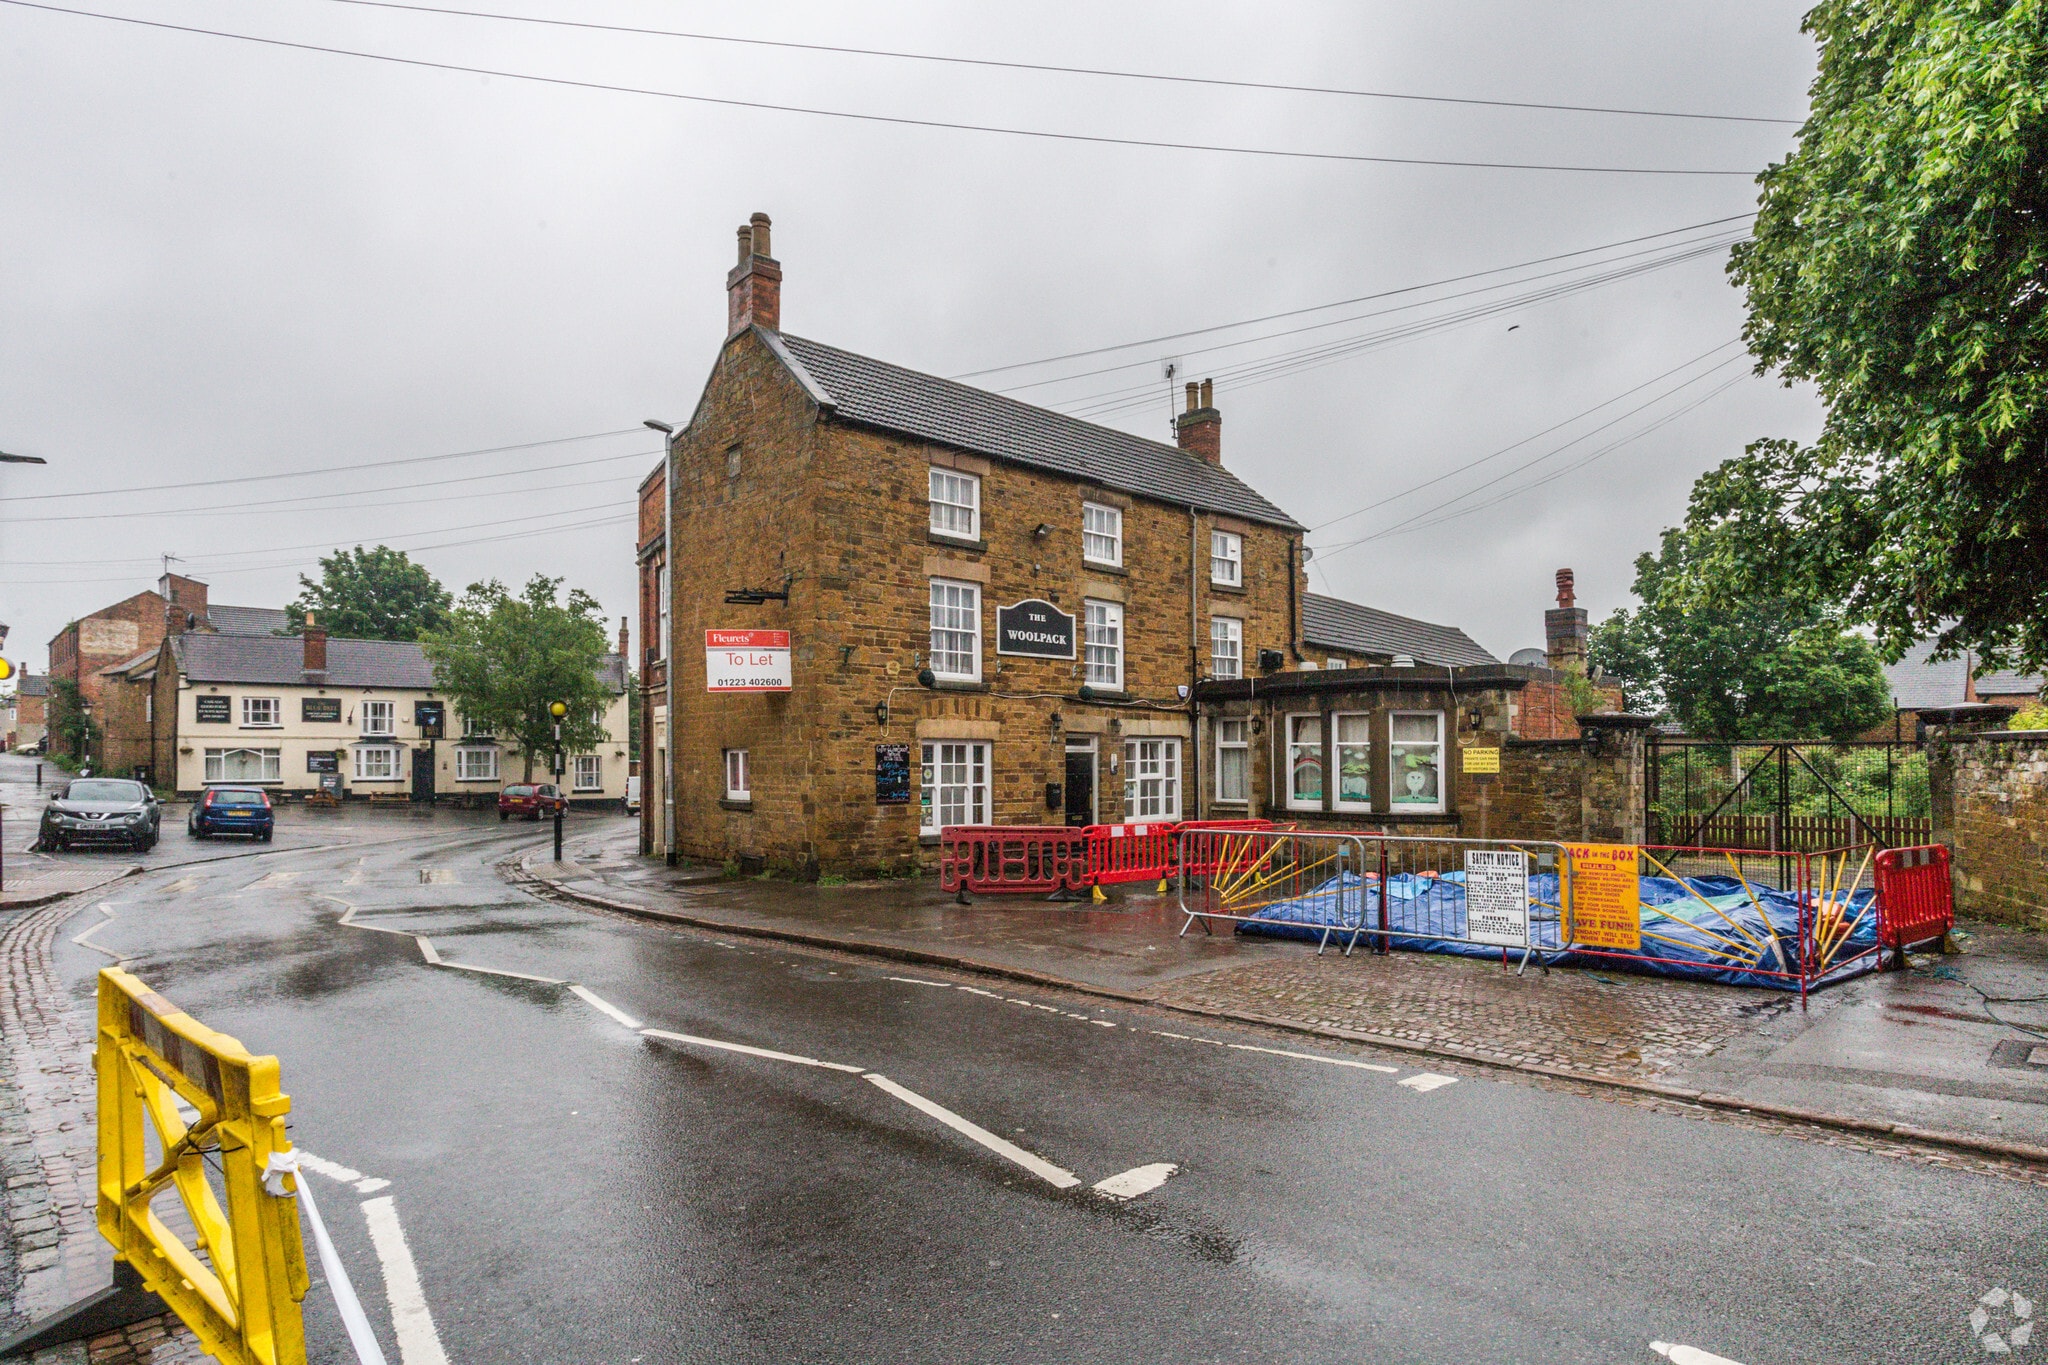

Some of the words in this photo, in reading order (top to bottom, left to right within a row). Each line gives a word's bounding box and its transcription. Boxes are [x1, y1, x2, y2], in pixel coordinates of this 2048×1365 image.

[1028, 613, 1046, 622] THE
[713, 634, 750, 643] Fleurets
[1007, 629, 1066, 645] WOOLPACK
[726, 652, 744, 665] To
[750, 653, 773, 666] Let
[1472, 853, 1494, 865] SAFETY
[1497, 854, 1519, 866] NOTICE
[1612, 849, 1633, 861] BOX
